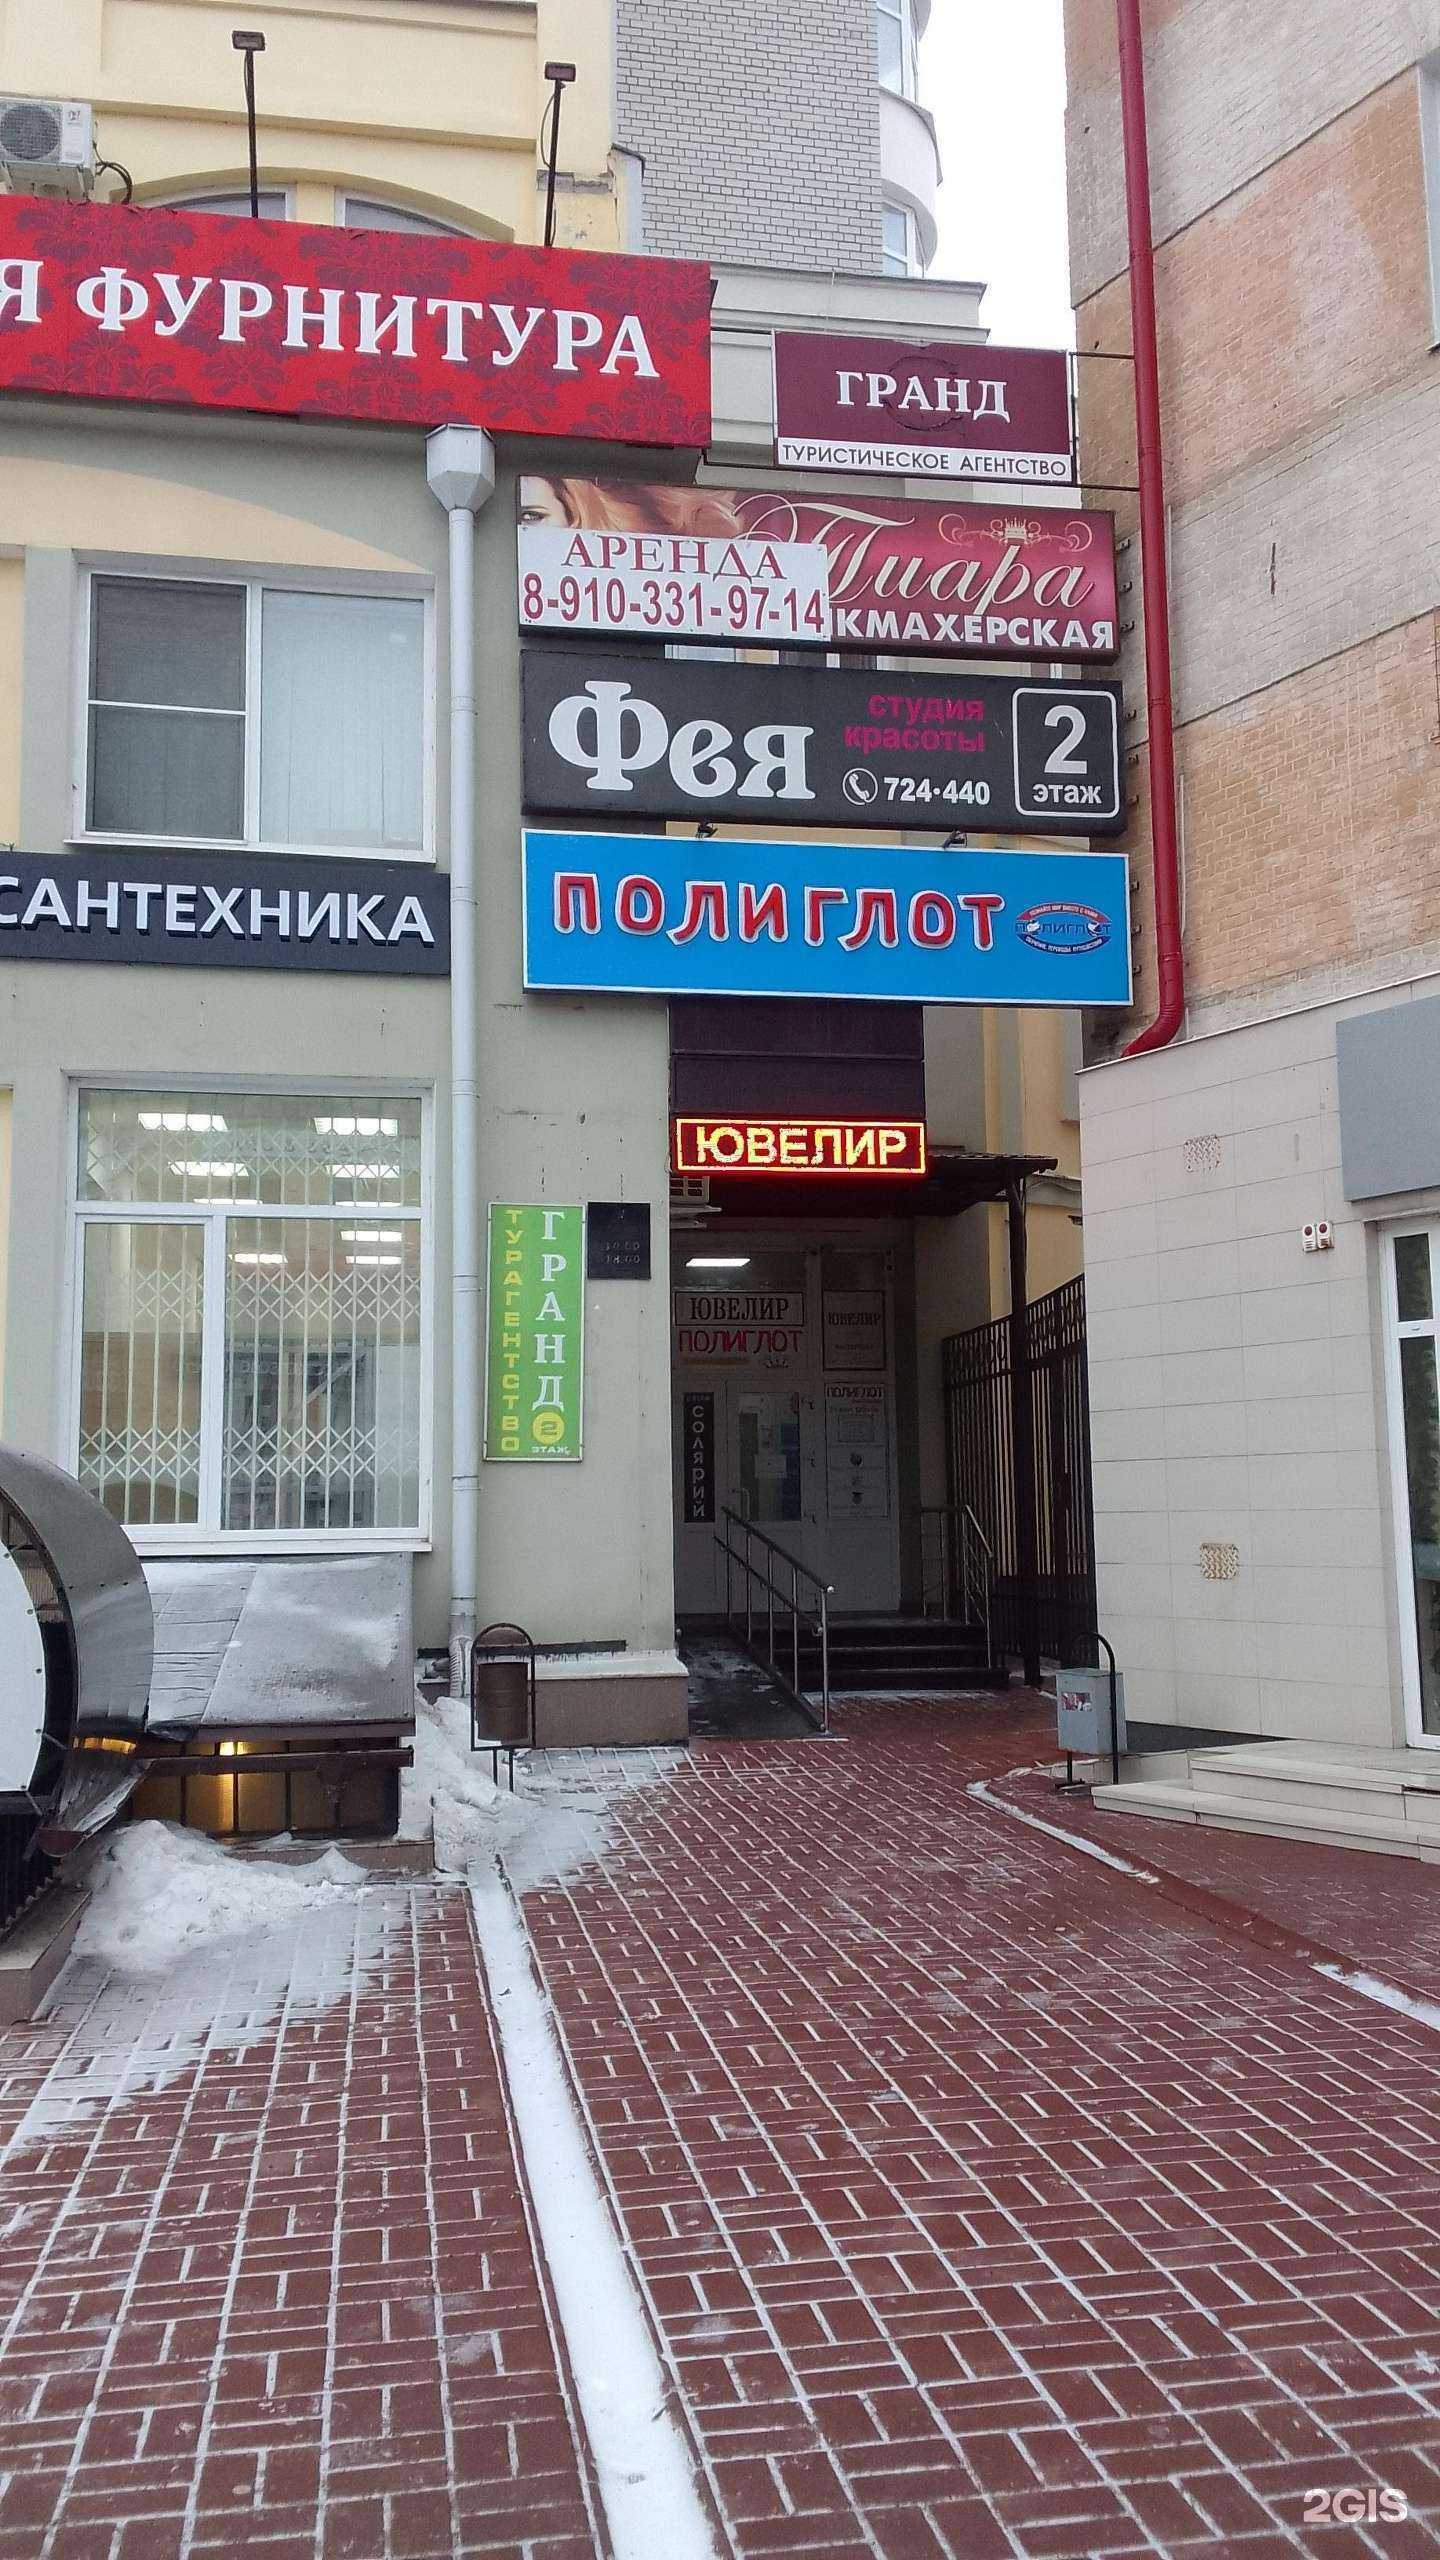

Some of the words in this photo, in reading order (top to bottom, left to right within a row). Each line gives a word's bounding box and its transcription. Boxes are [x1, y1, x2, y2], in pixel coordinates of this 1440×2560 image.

[76, 266, 660, 378] ФУРНИТУРА
[835, 370, 1011, 424] ГРАНД
[783, 444, 949, 470] ТУРИСТИЧЕСКОЕ
[959, 455, 1067, 476] АГЕНТСТВО
[560, 532, 788, 583] АРЕНДА
[523, 572, 825, 633] 8-910-331-97-14
[830, 607, 1115, 649] КМАХЕРСКАЯ
[867, 694, 985, 724] студия
[548, 679, 816, 800] Фея
[843, 726, 985, 756] красоты
[1044, 704, 1088, 775] 2
[1032, 783, 1103, 805] этаж
[553, 871, 1006, 953] ПОЛИГЛОТ
[696, 1125, 908, 1166] ЮВЕЛИР
[501, 1209, 524, 1452] ТУРАГЕНТСТВО
[532, 1210, 567, 1413] ГРАНД
[689, 1296, 790, 1320] ЮВЕЛИР
[678, 1329, 804, 1354] ПОЛИГЛОТ
[692, 1404, 706, 1518] СОЛЯРИЙ
